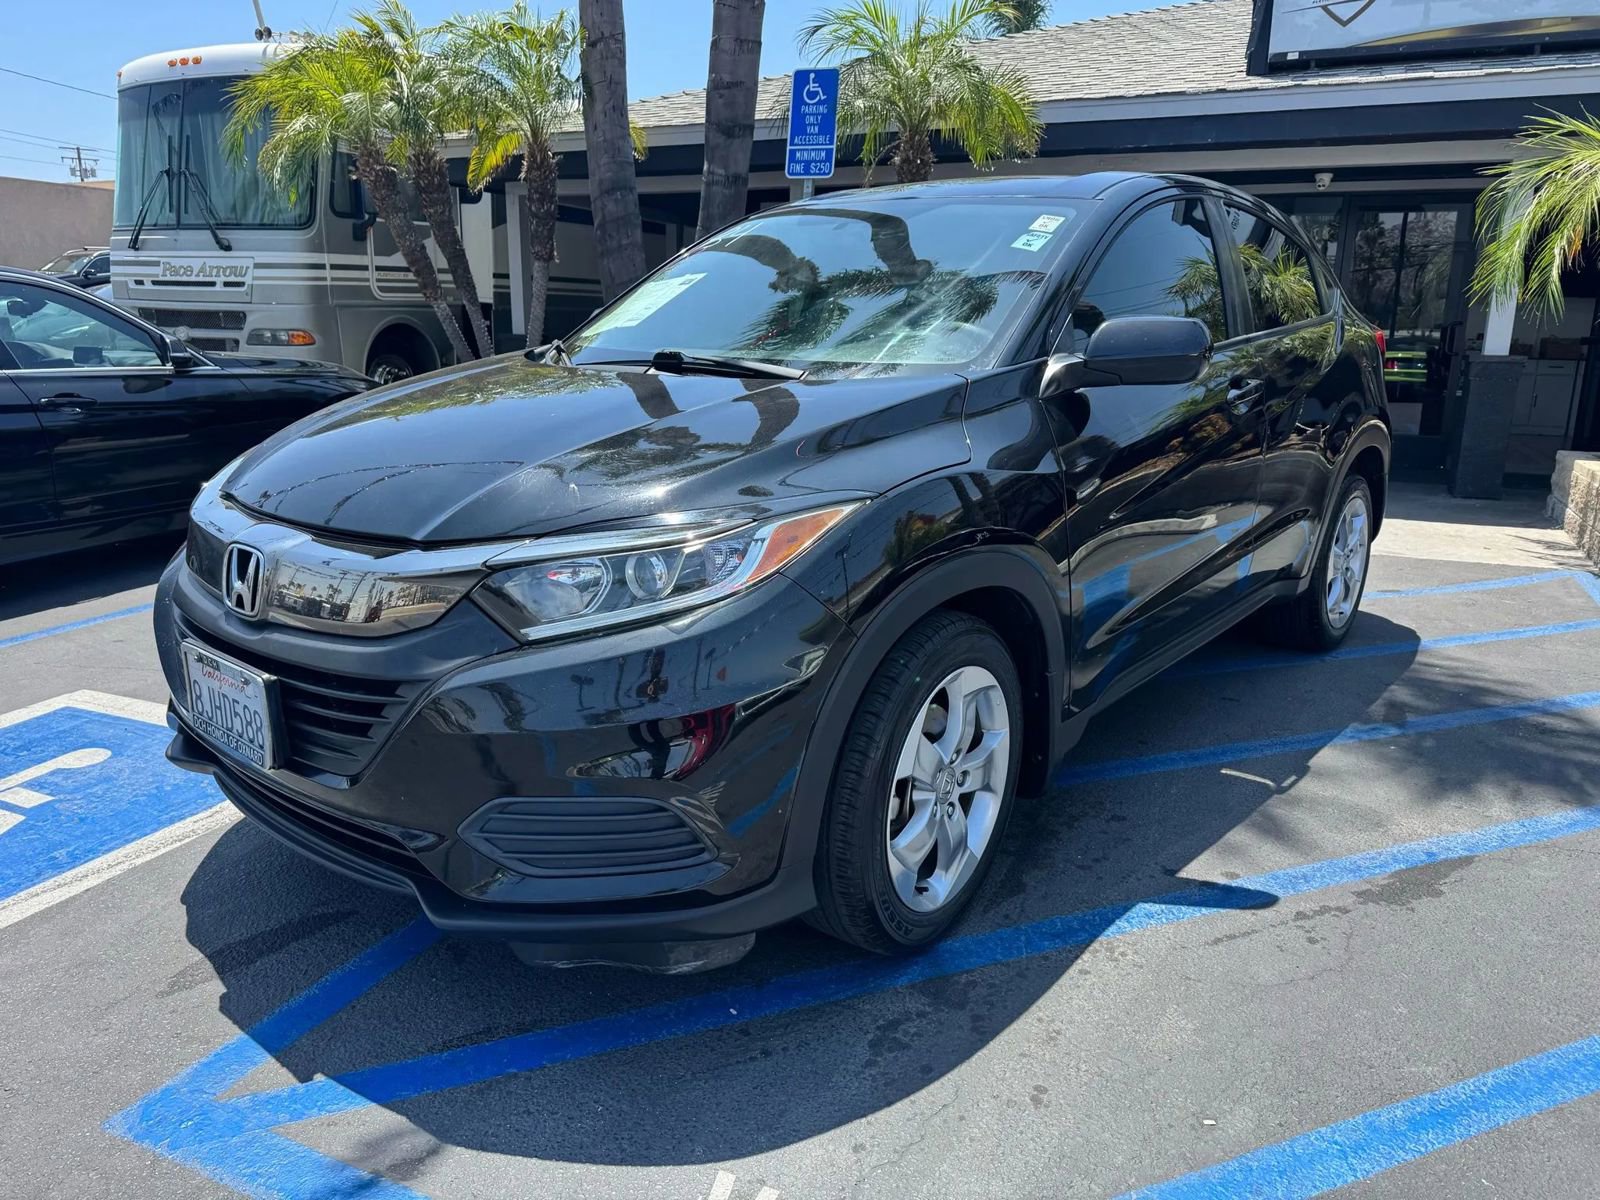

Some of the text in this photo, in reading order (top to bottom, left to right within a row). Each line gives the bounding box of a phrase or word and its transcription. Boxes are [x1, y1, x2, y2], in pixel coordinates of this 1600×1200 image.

[801, 105, 828, 114] PARKING
[805, 115, 821, 124] ONLY
[806, 125, 819, 134] VAN
[793, 135, 830, 144] ACCESSIBLE
[795, 150, 826, 160] MINIMUM
[789, 163, 804, 173] FINE
[160, 261, 250, 278] Pace Arrow
[193, 679, 264, 749] 8JHD588
[207, 724, 228, 744] HONDA
[228, 736, 238, 748] OF
[239, 743, 263, 766] OXNARD
